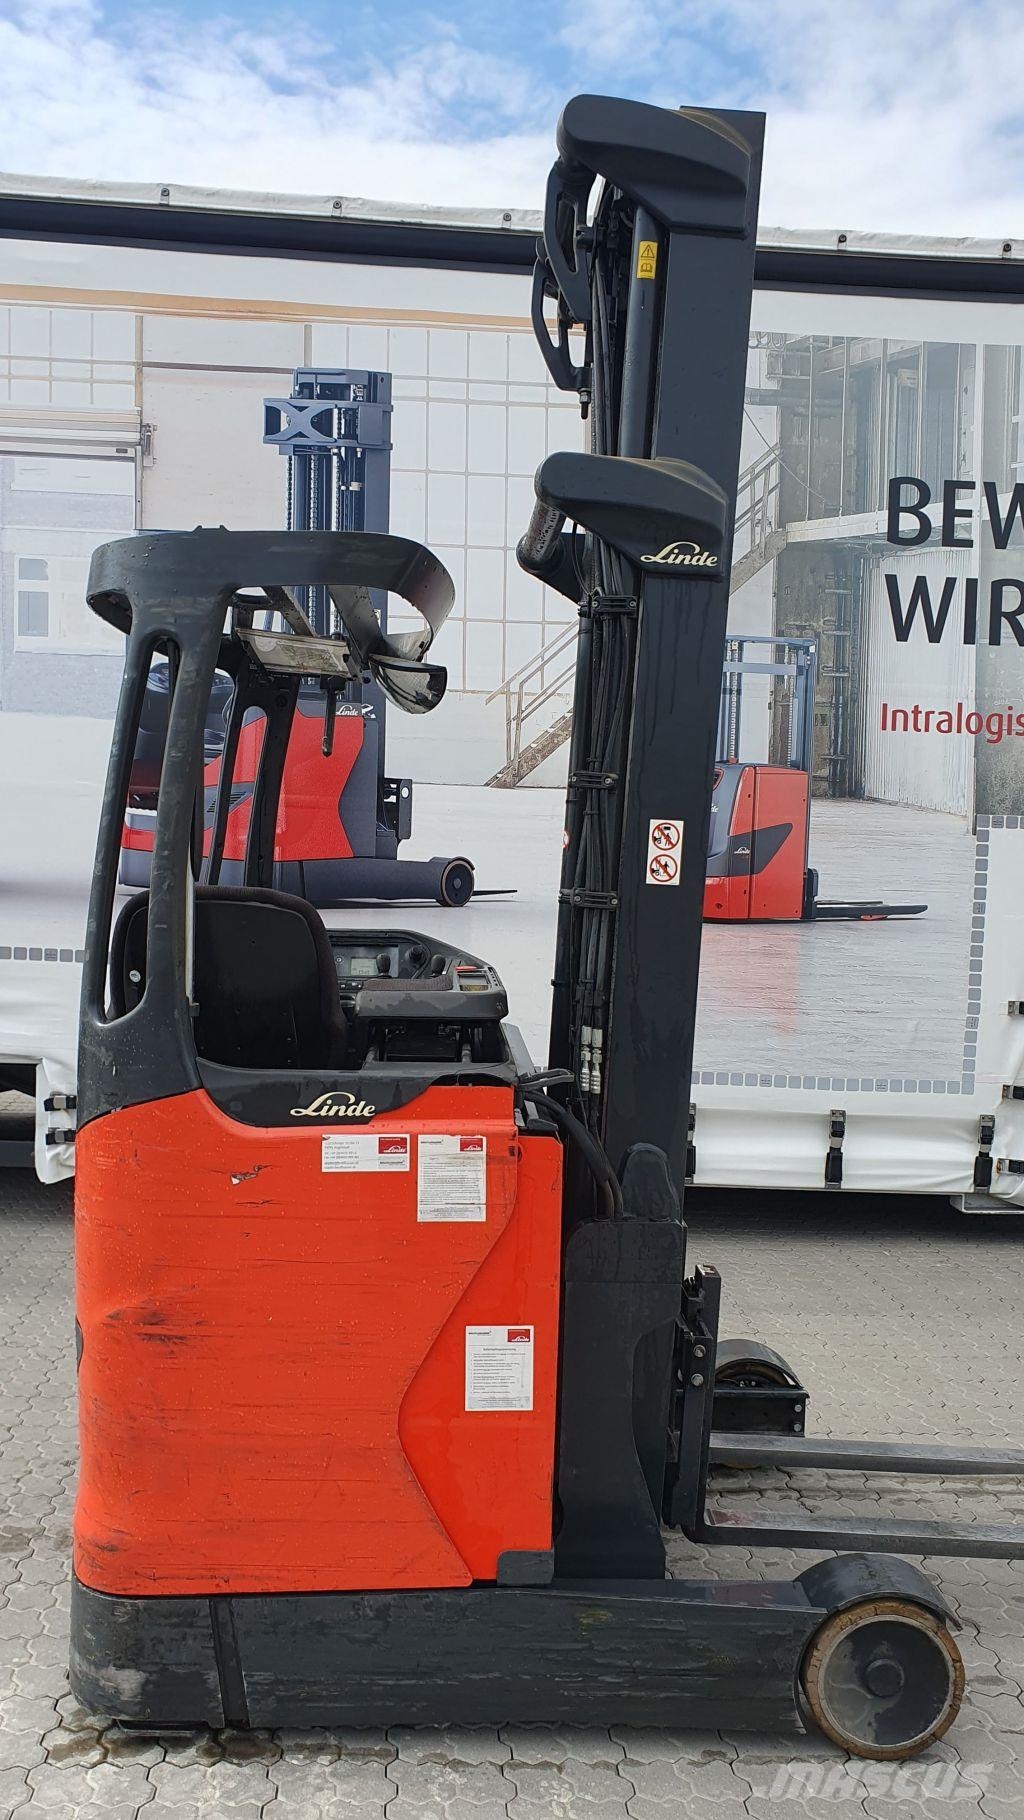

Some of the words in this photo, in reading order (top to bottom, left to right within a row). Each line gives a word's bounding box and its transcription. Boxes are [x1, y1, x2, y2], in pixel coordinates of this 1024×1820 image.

[640, 541, 718, 567] Linde
[884, 573, 1024, 647] WIR
[336, 704, 359, 716] Linde
[290, 1091, 376, 1117] Linde
